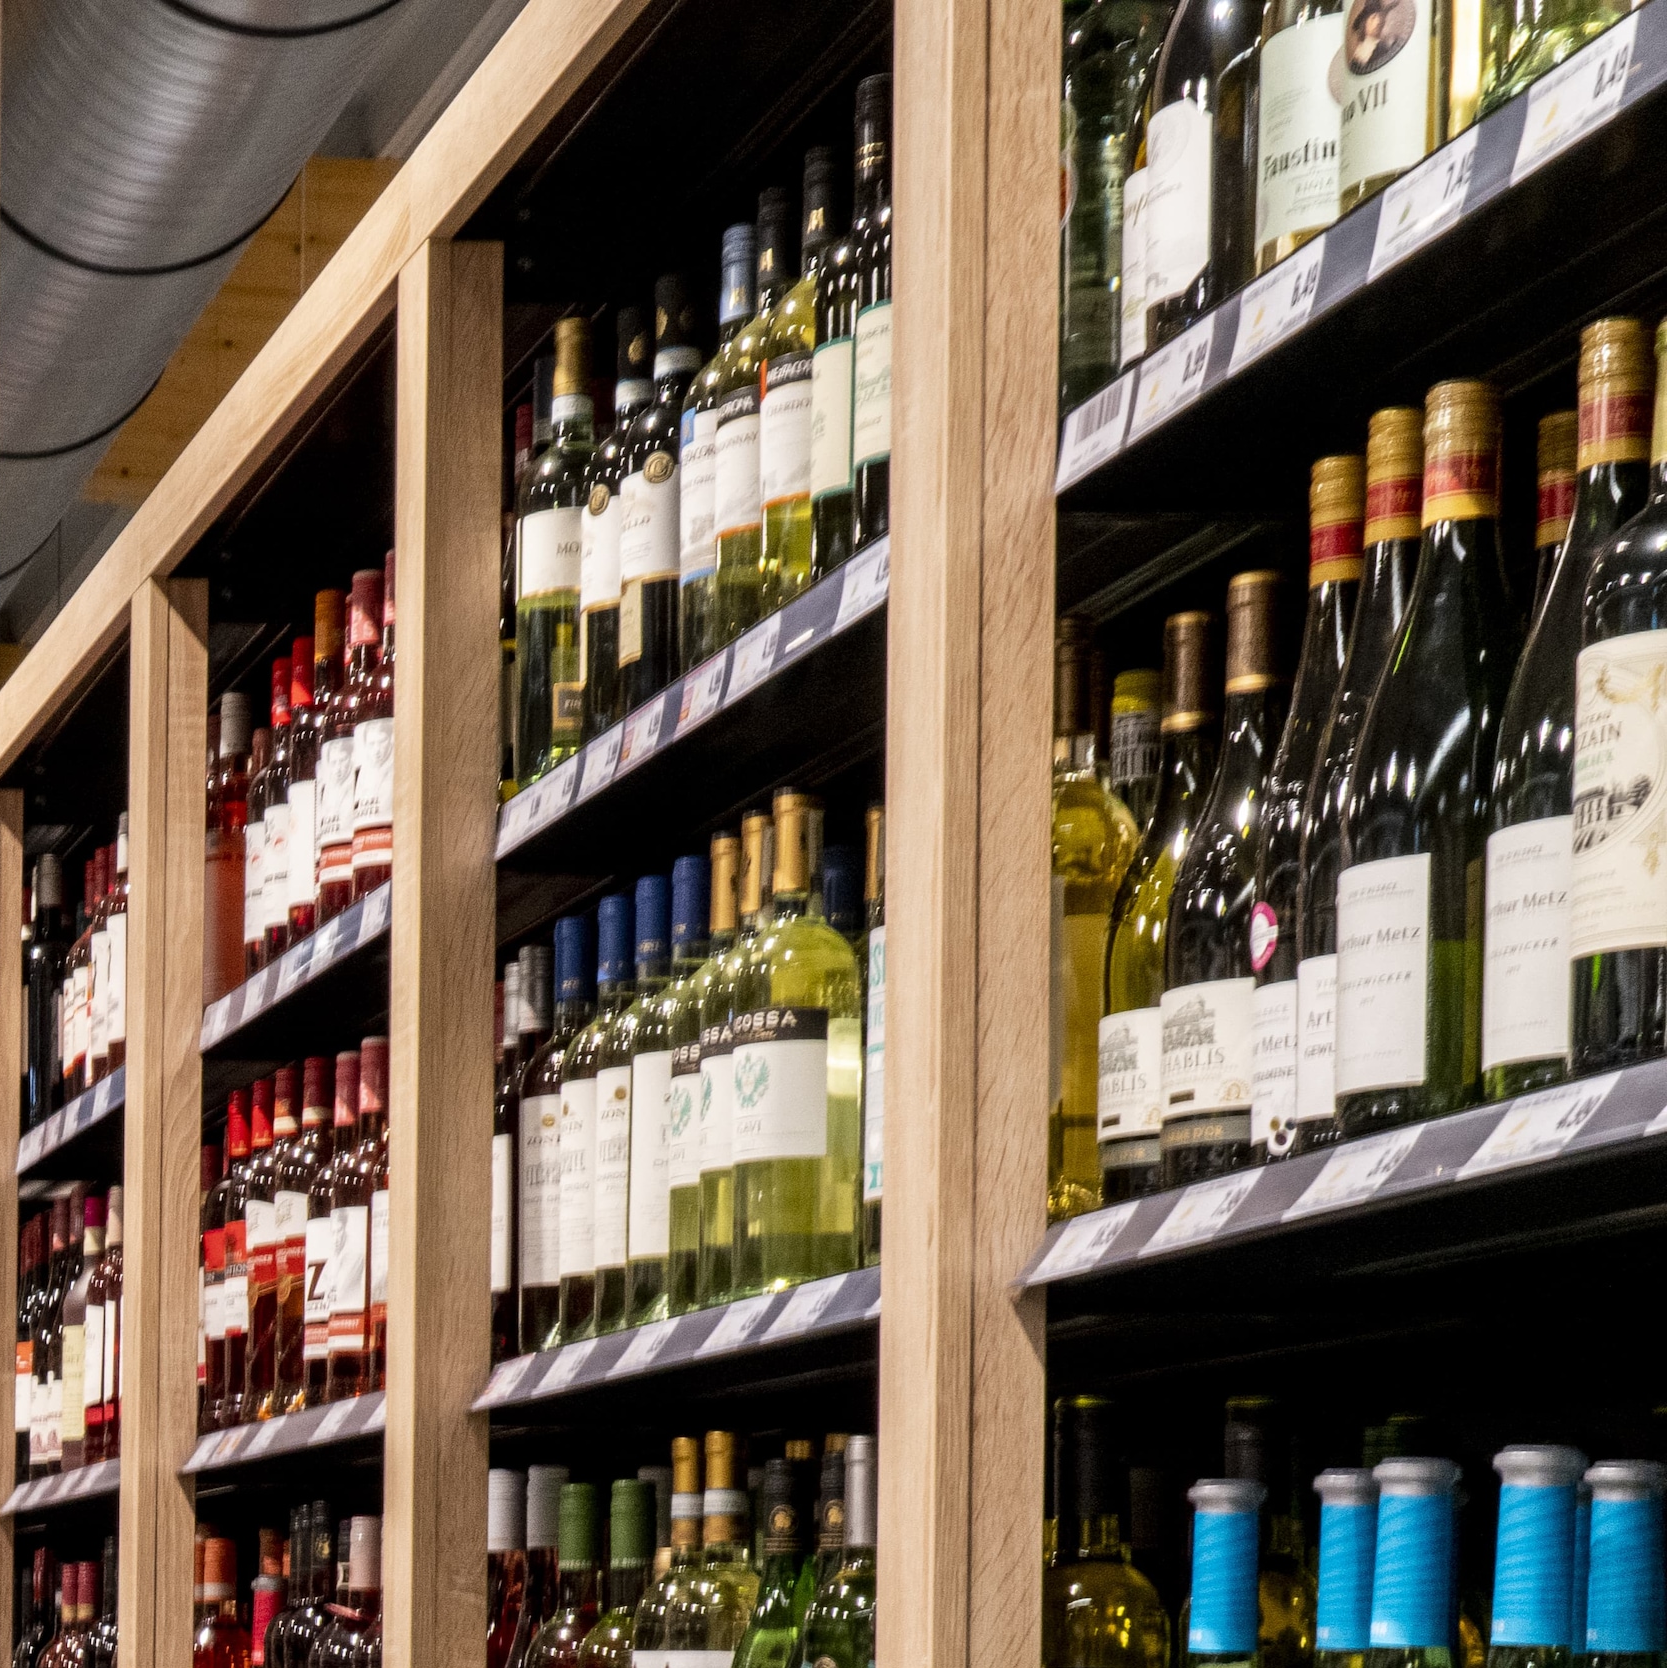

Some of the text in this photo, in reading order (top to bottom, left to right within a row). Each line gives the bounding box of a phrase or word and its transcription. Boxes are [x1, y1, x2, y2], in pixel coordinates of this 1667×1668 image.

[1357, 79, 1389, 118] VII
[1263, 136, 1339, 183] Faustin
[1522, 888, 1568, 909] Metz
[1376, 925, 1421, 946] Metz
